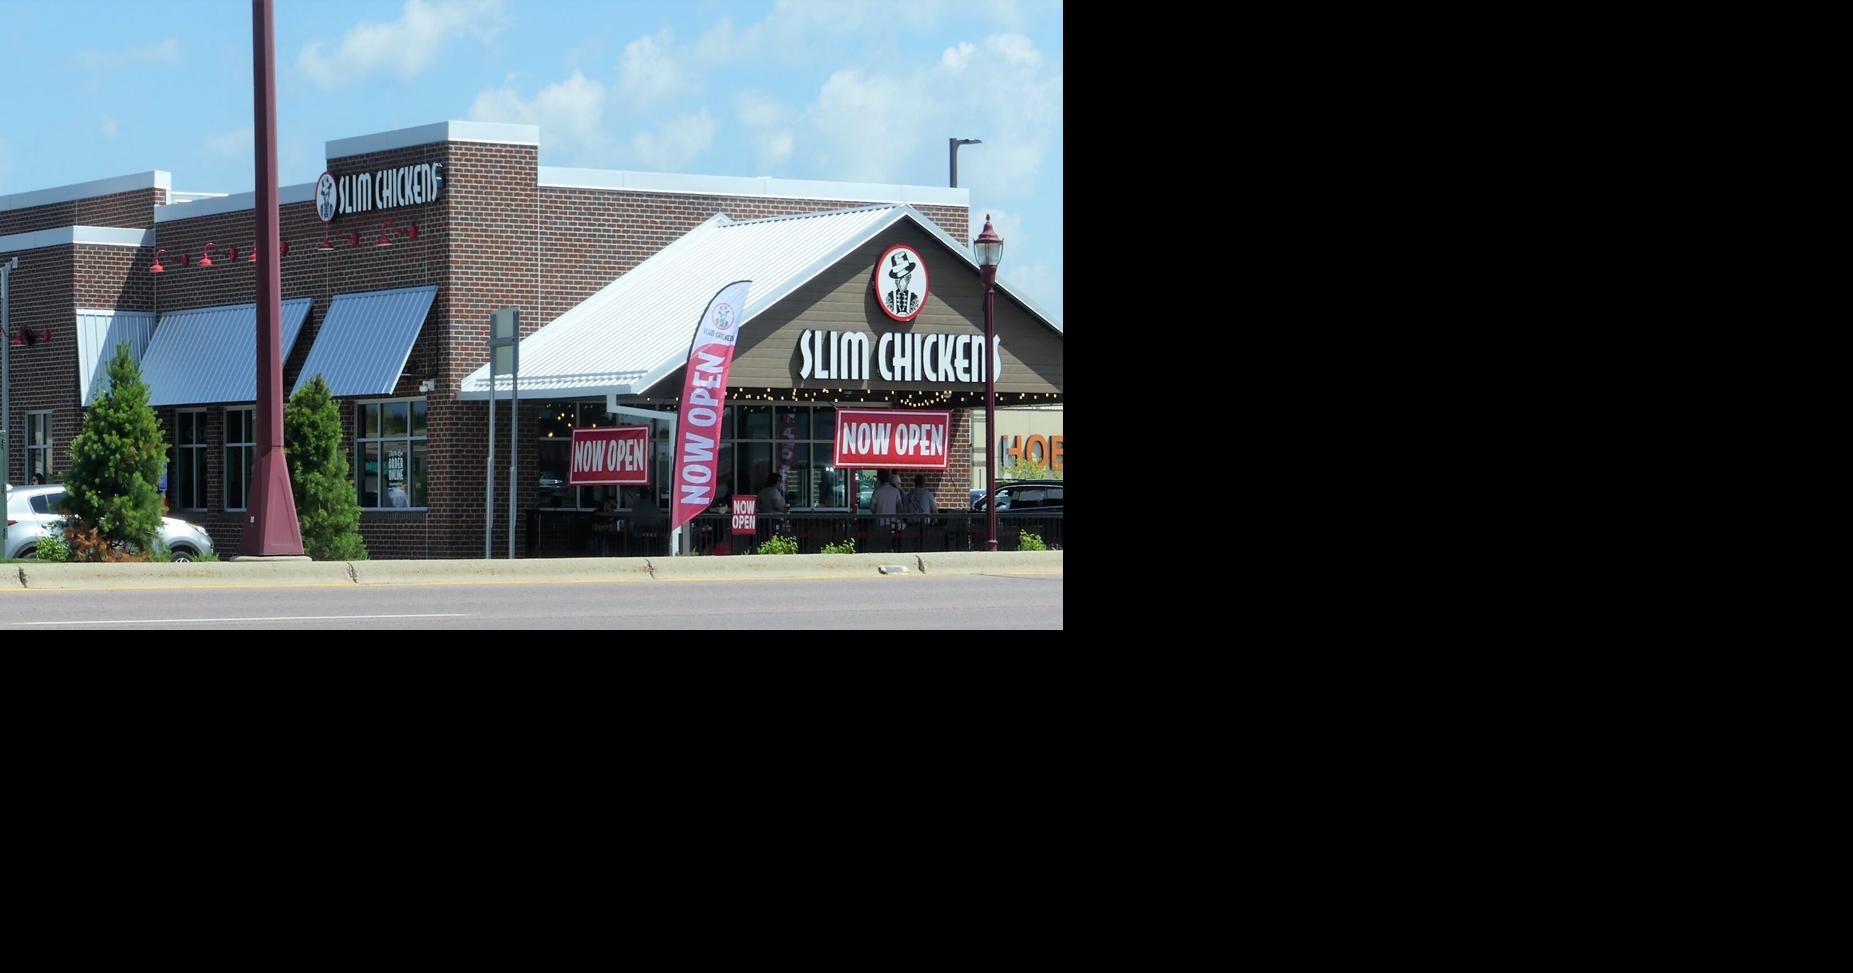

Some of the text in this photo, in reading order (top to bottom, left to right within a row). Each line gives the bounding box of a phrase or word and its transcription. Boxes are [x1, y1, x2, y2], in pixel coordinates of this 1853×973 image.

[339, 161, 441, 215] SLIM CHICKENS
[800, 328, 1002, 384] SLIM CHICKENS
[687, 351, 726, 428] OPEN
[574, 438, 644, 473] NOW OPEN
[841, 421, 944, 457] NOW OPEN
[679, 432, 715, 506] NOW
[731, 514, 756, 529] OPEN
[733, 500, 755, 515] NOW
